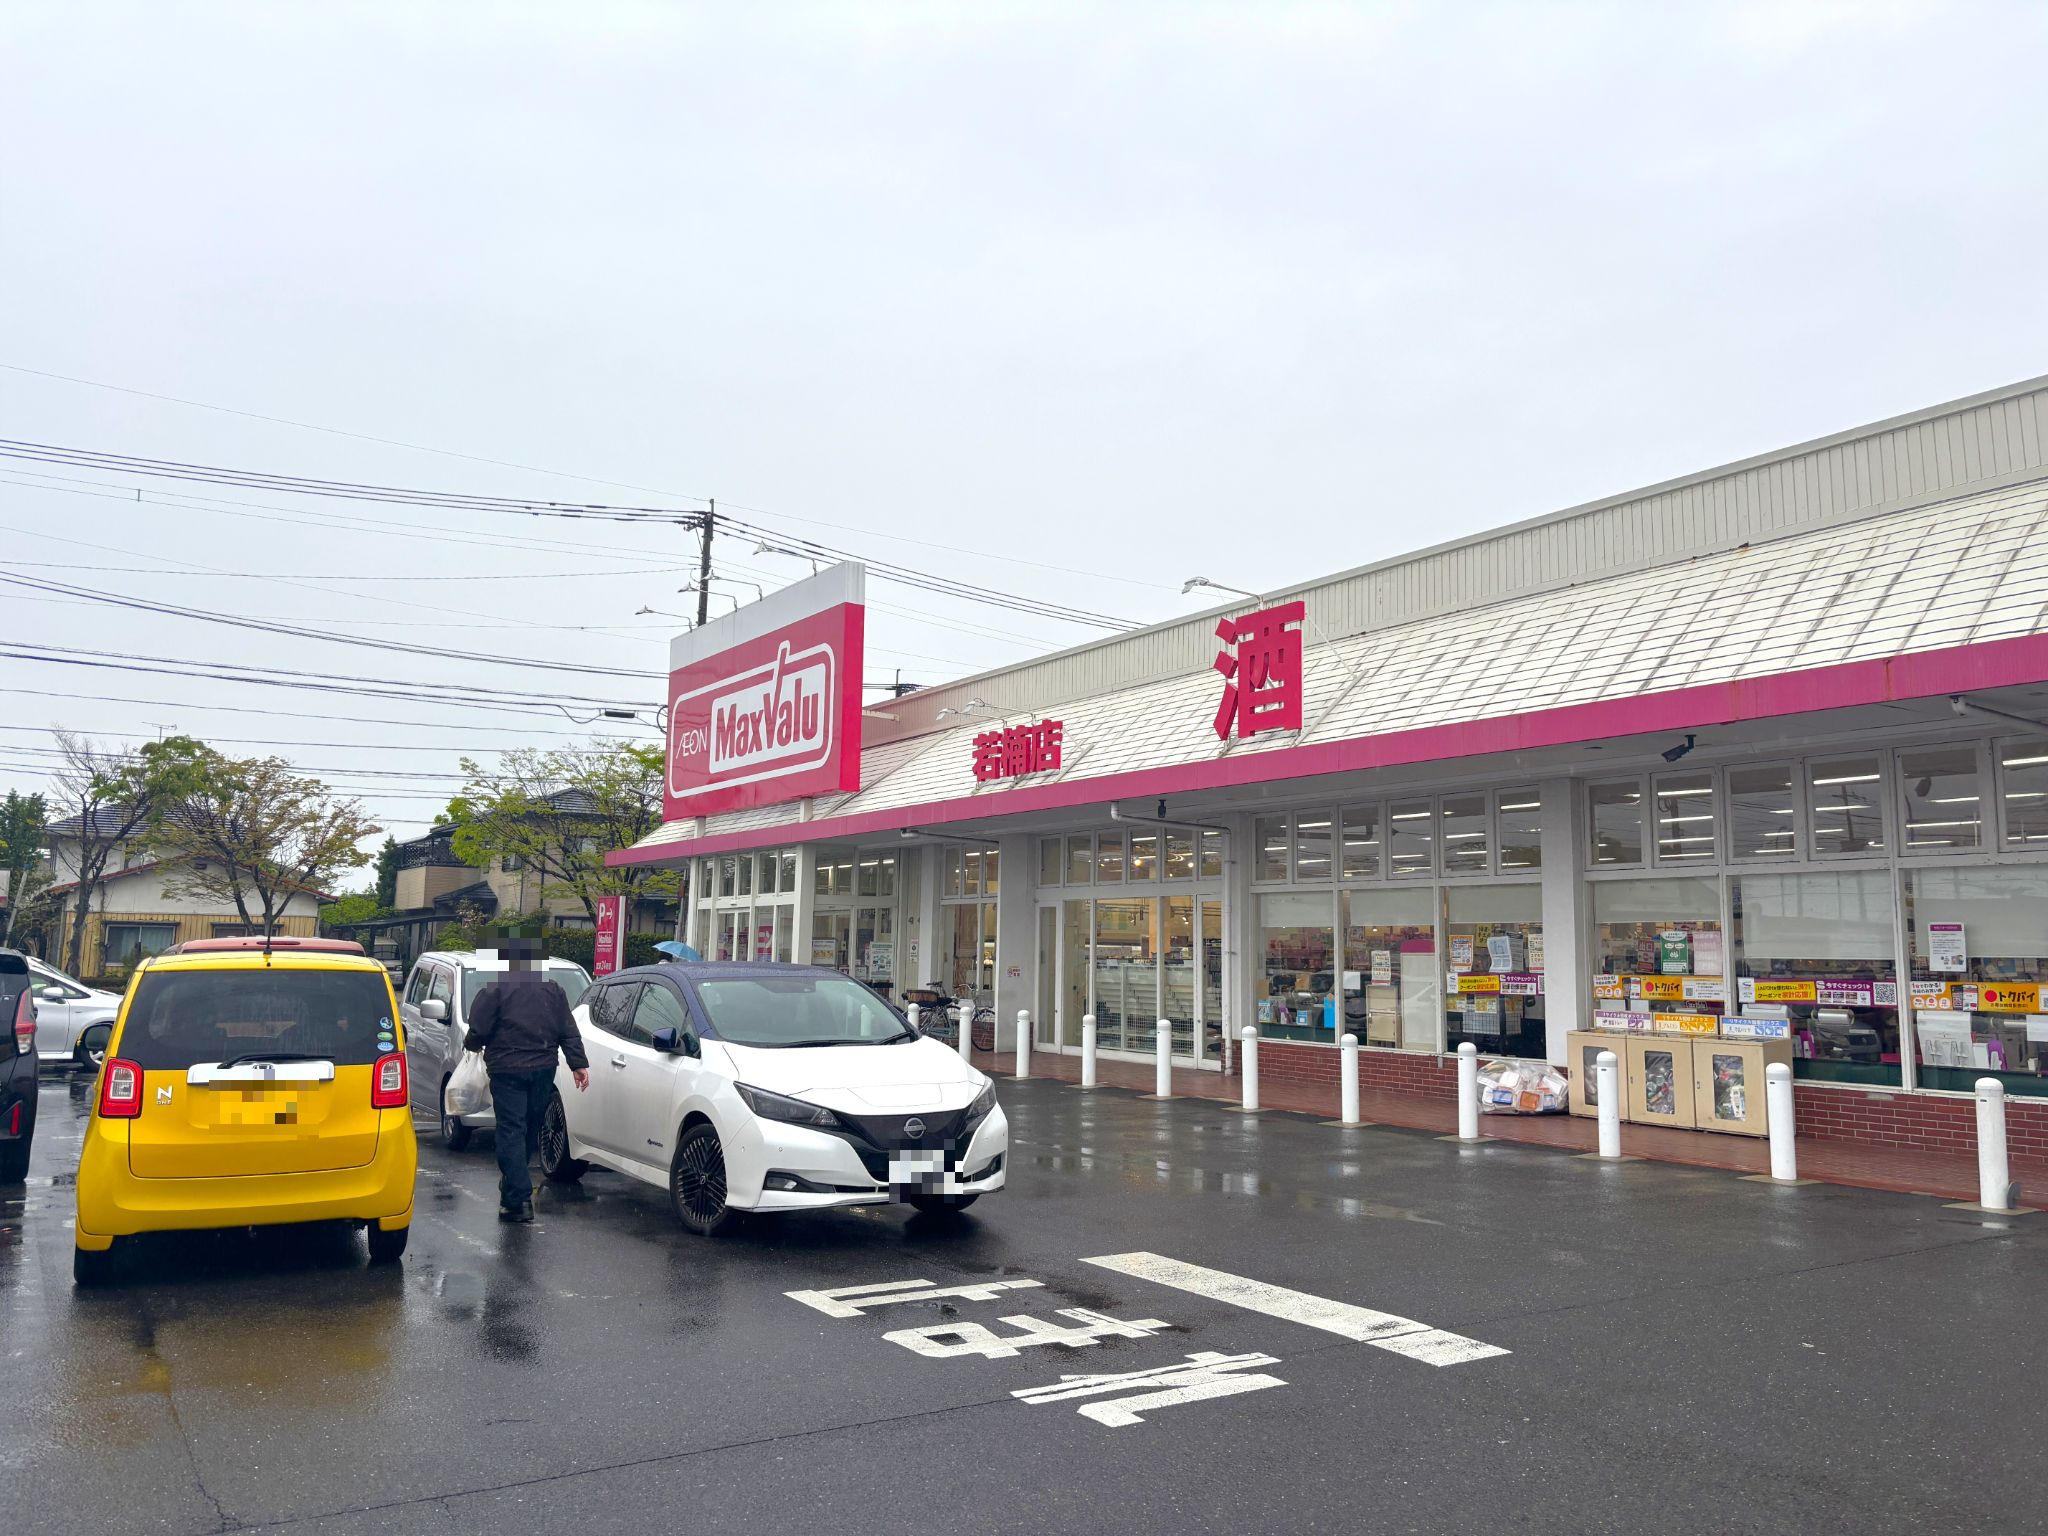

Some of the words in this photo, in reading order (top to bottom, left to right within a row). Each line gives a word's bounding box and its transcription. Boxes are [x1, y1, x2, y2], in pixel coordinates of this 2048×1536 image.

[1213, 600, 1305, 741] 酒
[714, 647, 819, 763] MaxValu
[971, 719, 1063, 782] 若楠店
[598, 902, 606, 926] P
[1654, 982, 1680, 992] トクバイ
[1998, 990, 2036, 1003] トクバイ
[157, 1085, 173, 1100] N
